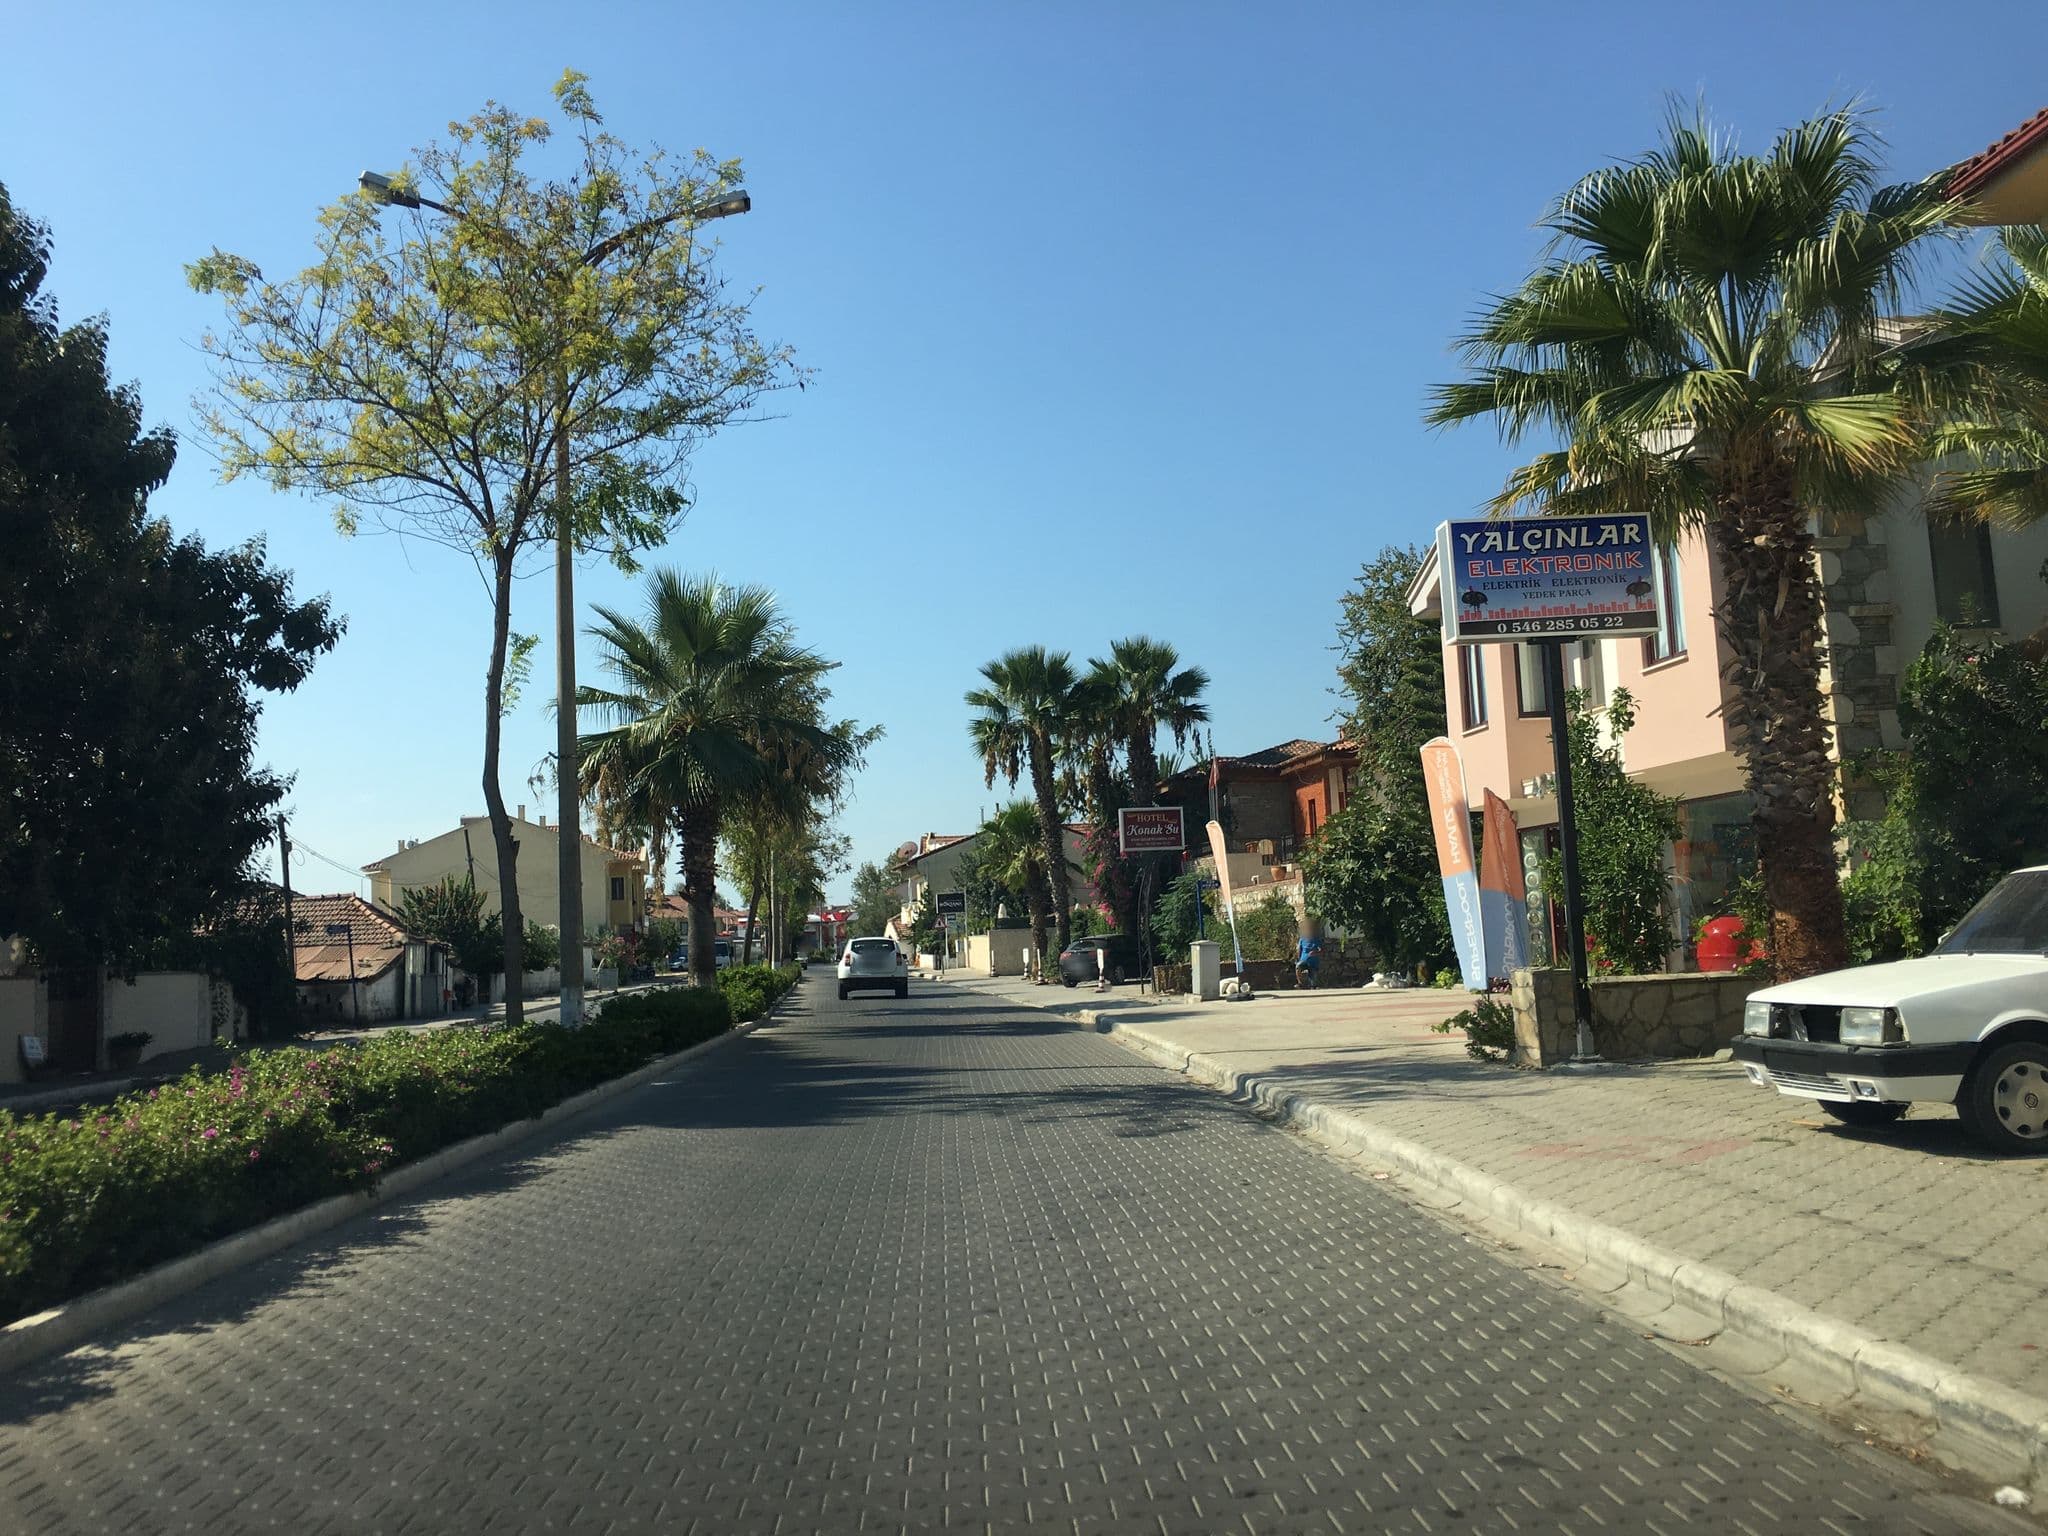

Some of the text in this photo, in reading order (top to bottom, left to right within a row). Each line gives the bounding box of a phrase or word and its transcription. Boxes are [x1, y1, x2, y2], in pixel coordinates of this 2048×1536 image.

[1460, 523, 1642, 554] YALÇINLAR
[1482, 573, 1628, 591] ELEKTRİK ELEKTRONİK
[1522, 588, 1592, 600] YEDEK PARÇA
[1498, 616, 1624, 634] 0 546 285 05 22
[1137, 813, 1169, 823] HOTEL
[1126, 824, 1163, 836] Konak
